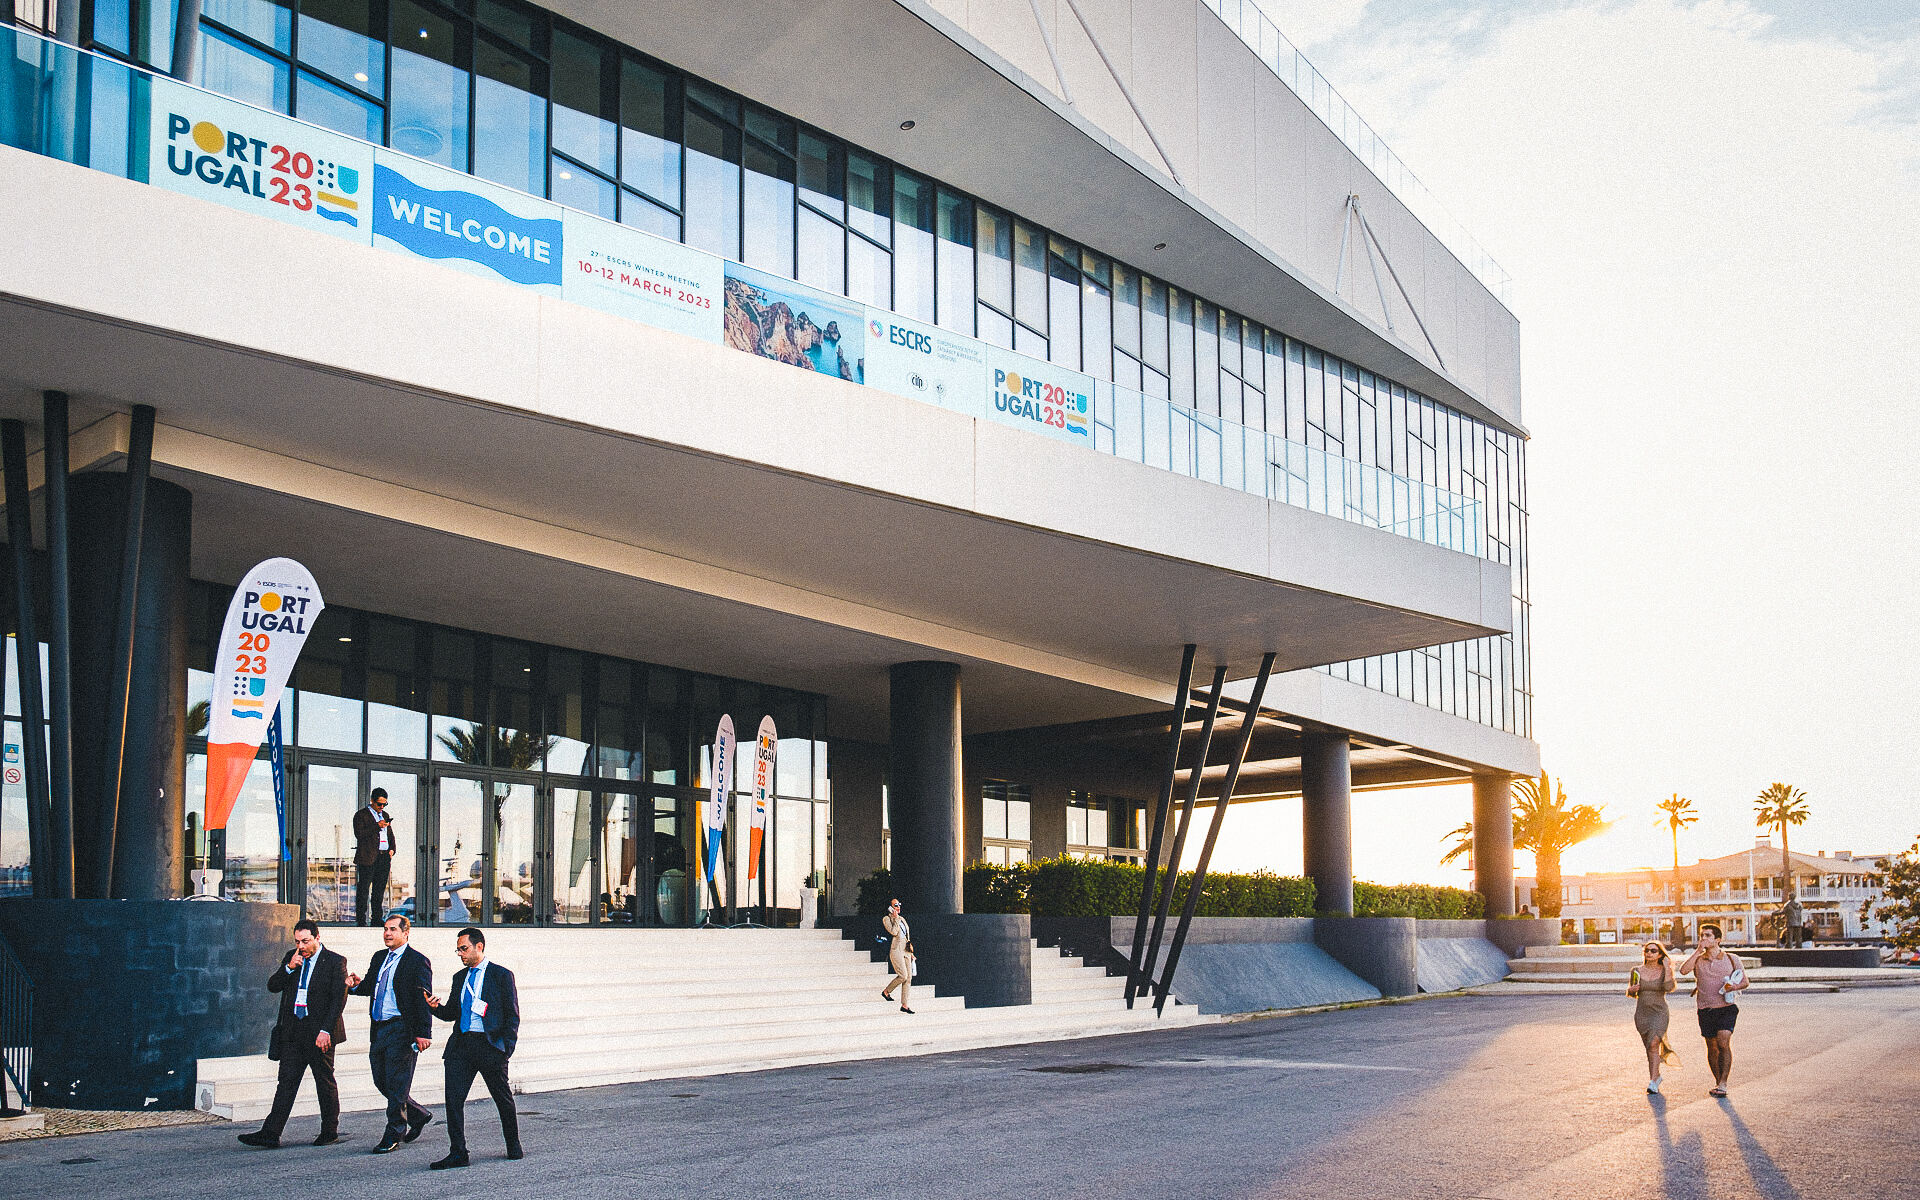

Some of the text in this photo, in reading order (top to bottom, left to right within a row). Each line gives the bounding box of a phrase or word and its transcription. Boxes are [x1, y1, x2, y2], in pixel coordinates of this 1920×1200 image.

[167, 144, 313, 211] UGAL 23
[270, 145, 314, 179] 20
[387, 194, 551, 265] WELCOME
[578, 260, 614, 281] 10-12
[620, 273, 672, 297] MARCH
[678, 290, 711, 309] 2023
[607, 255, 631, 267] ESCRS
[634, 264, 665, 277] WINTER
[668, 274, 701, 289] MEETING
[889, 324, 932, 355] ESCRS
[994, 390, 1065, 429] UGAL 23
[1043, 383, 1065, 406] 20
[241, 611, 306, 634] UGAL
[237, 631, 270, 652] 20
[234, 654, 267, 674] 23
[757, 774, 766, 786] 23
[758, 760, 766, 773] 20
